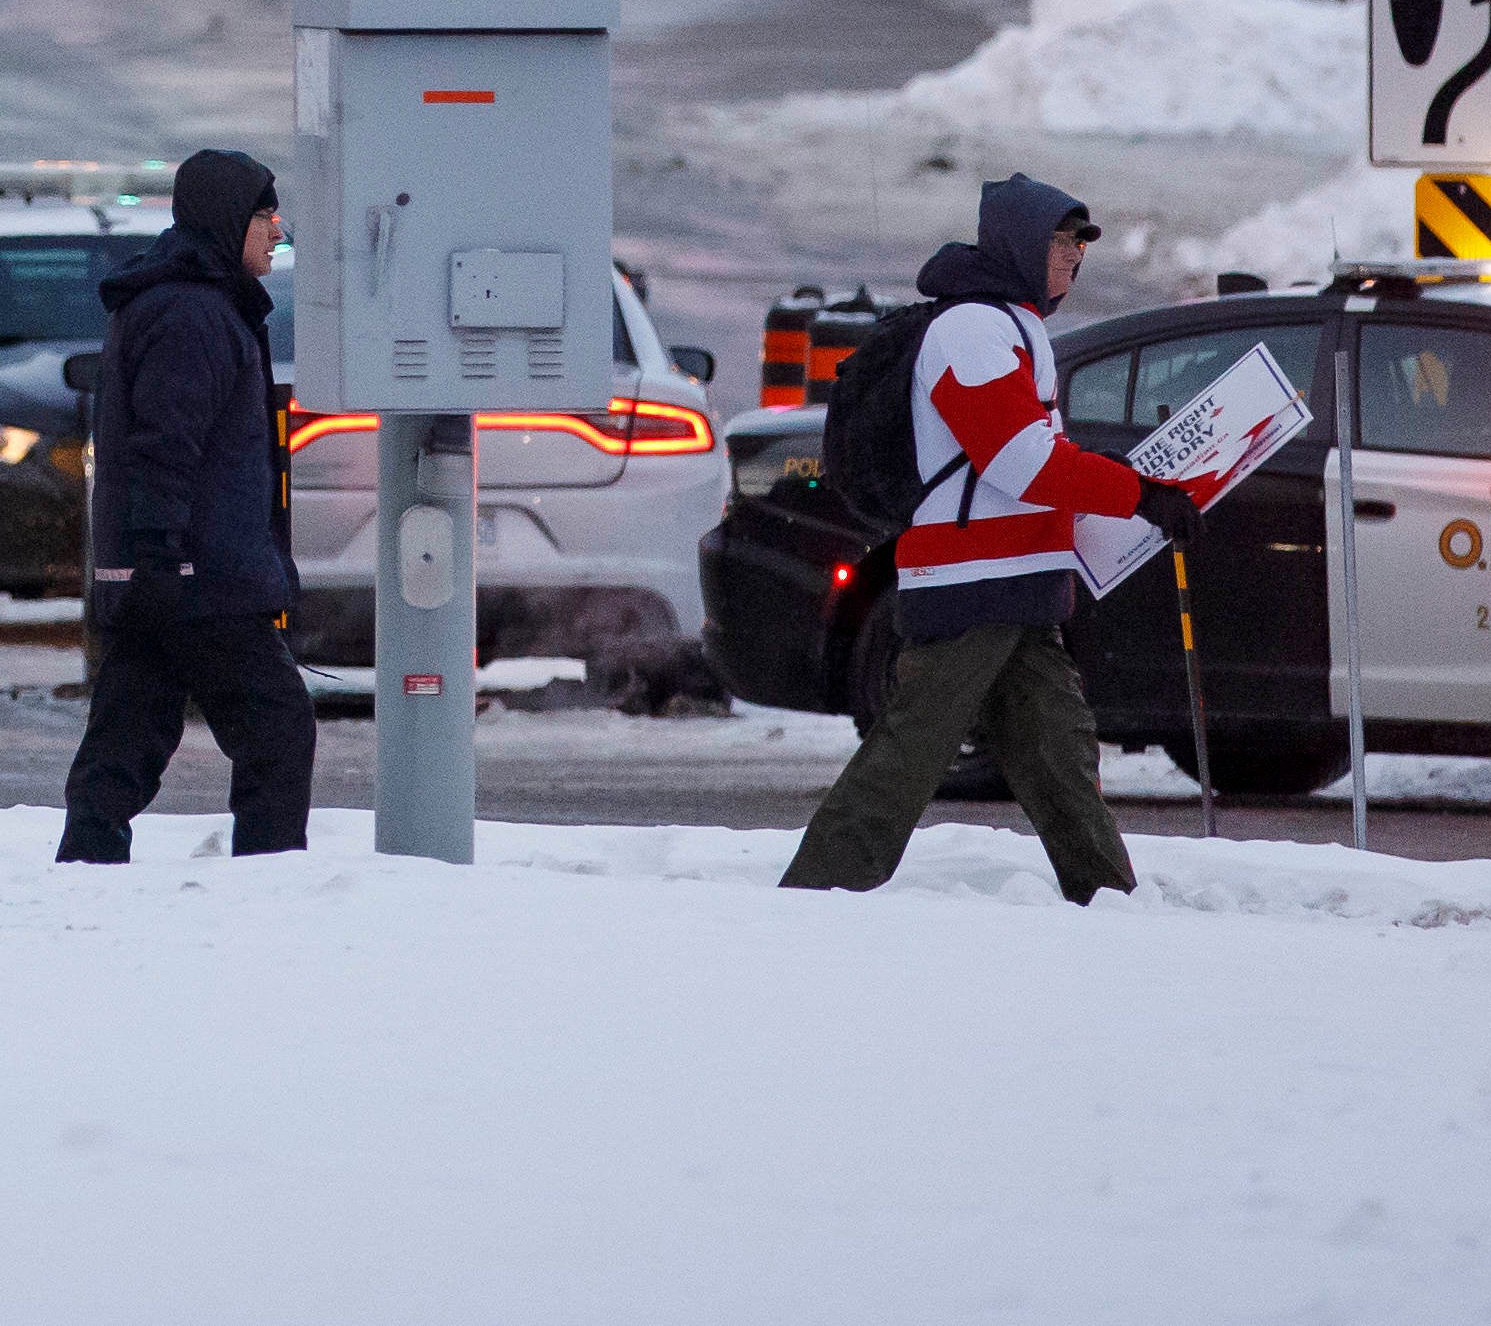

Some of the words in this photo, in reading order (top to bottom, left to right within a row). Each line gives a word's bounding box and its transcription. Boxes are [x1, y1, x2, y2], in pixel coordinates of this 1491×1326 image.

[1136, 437, 1168, 466] THE
[1167, 394, 1215, 440] RIGHT
[1142, 443, 1178, 476] IDE
[1180, 417, 1205, 443] OF
[1152, 423, 1215, 480] STORY
